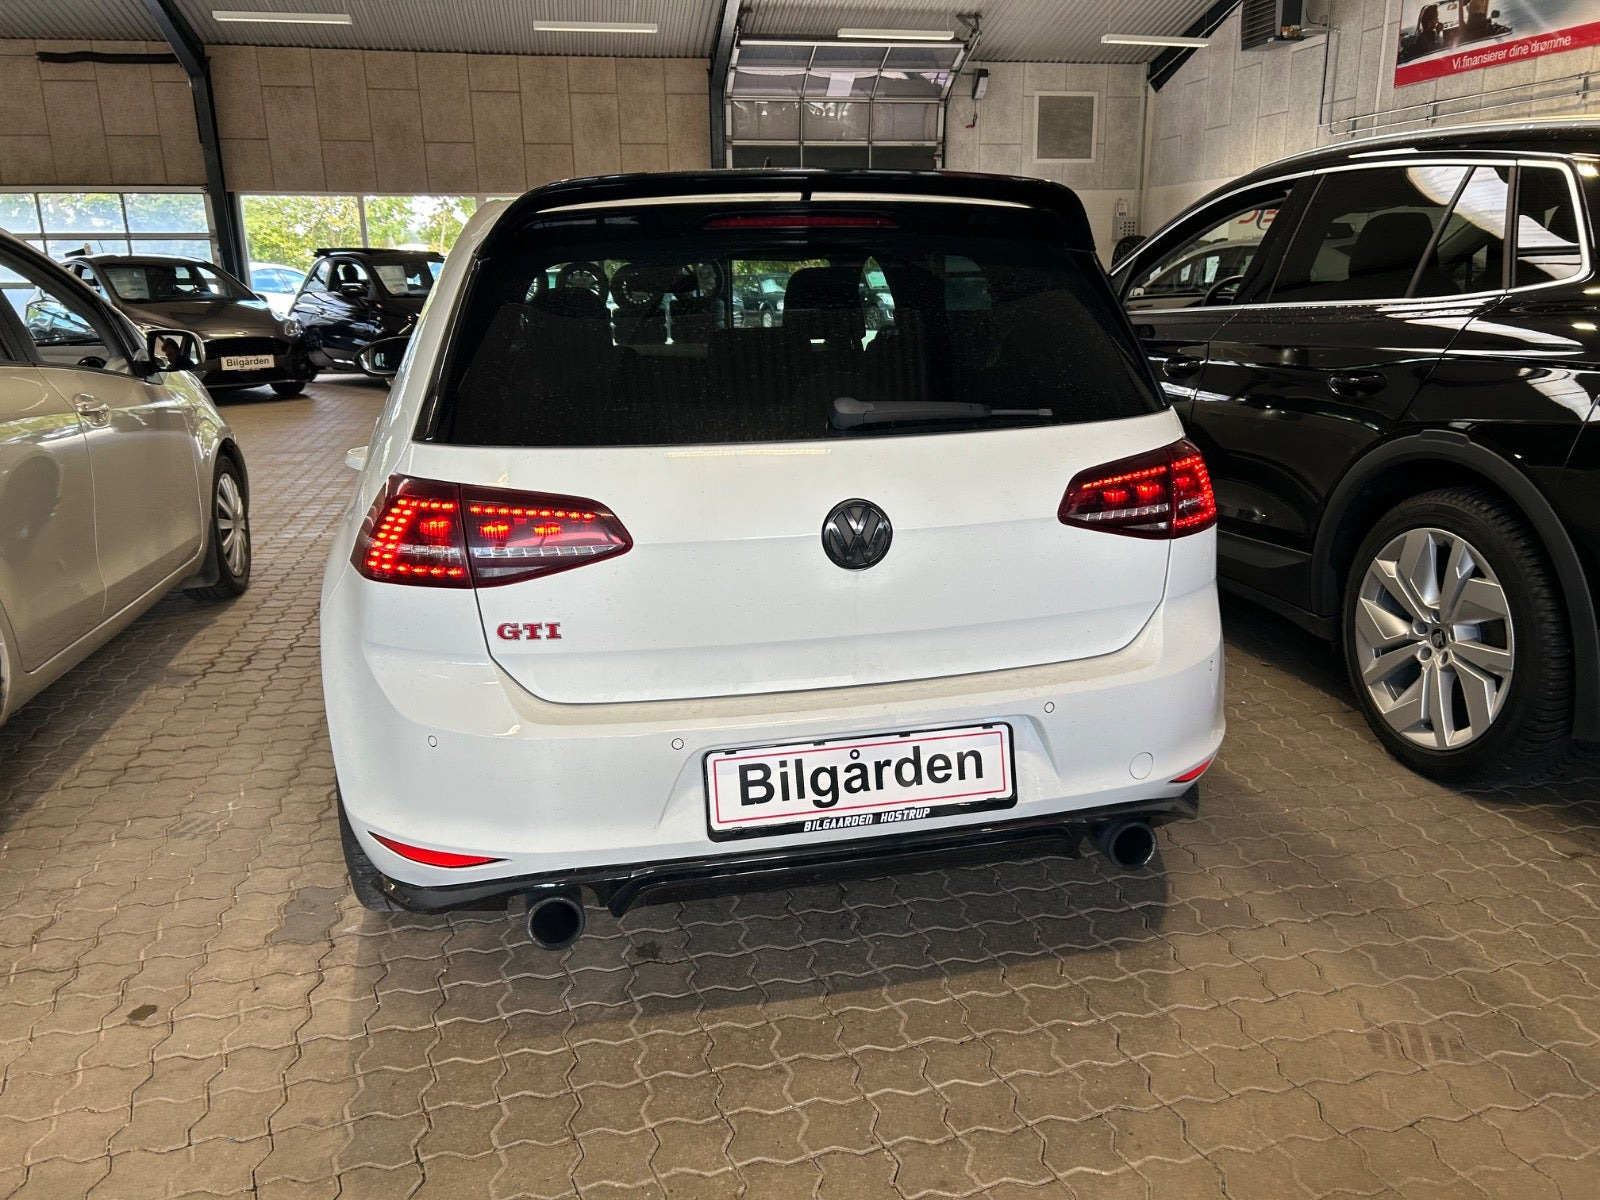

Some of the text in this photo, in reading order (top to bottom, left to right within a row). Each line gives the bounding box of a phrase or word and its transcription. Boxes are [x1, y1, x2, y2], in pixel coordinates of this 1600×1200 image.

[1452, 36, 1572, 69] Vi finansierer dine drømme
[226, 357, 270, 368] Bilgården
[496, 621, 562, 640] GTI
[737, 745, 984, 808] Bilgården
[803, 807, 931, 832] BILGAARDEN HOSTRUP
